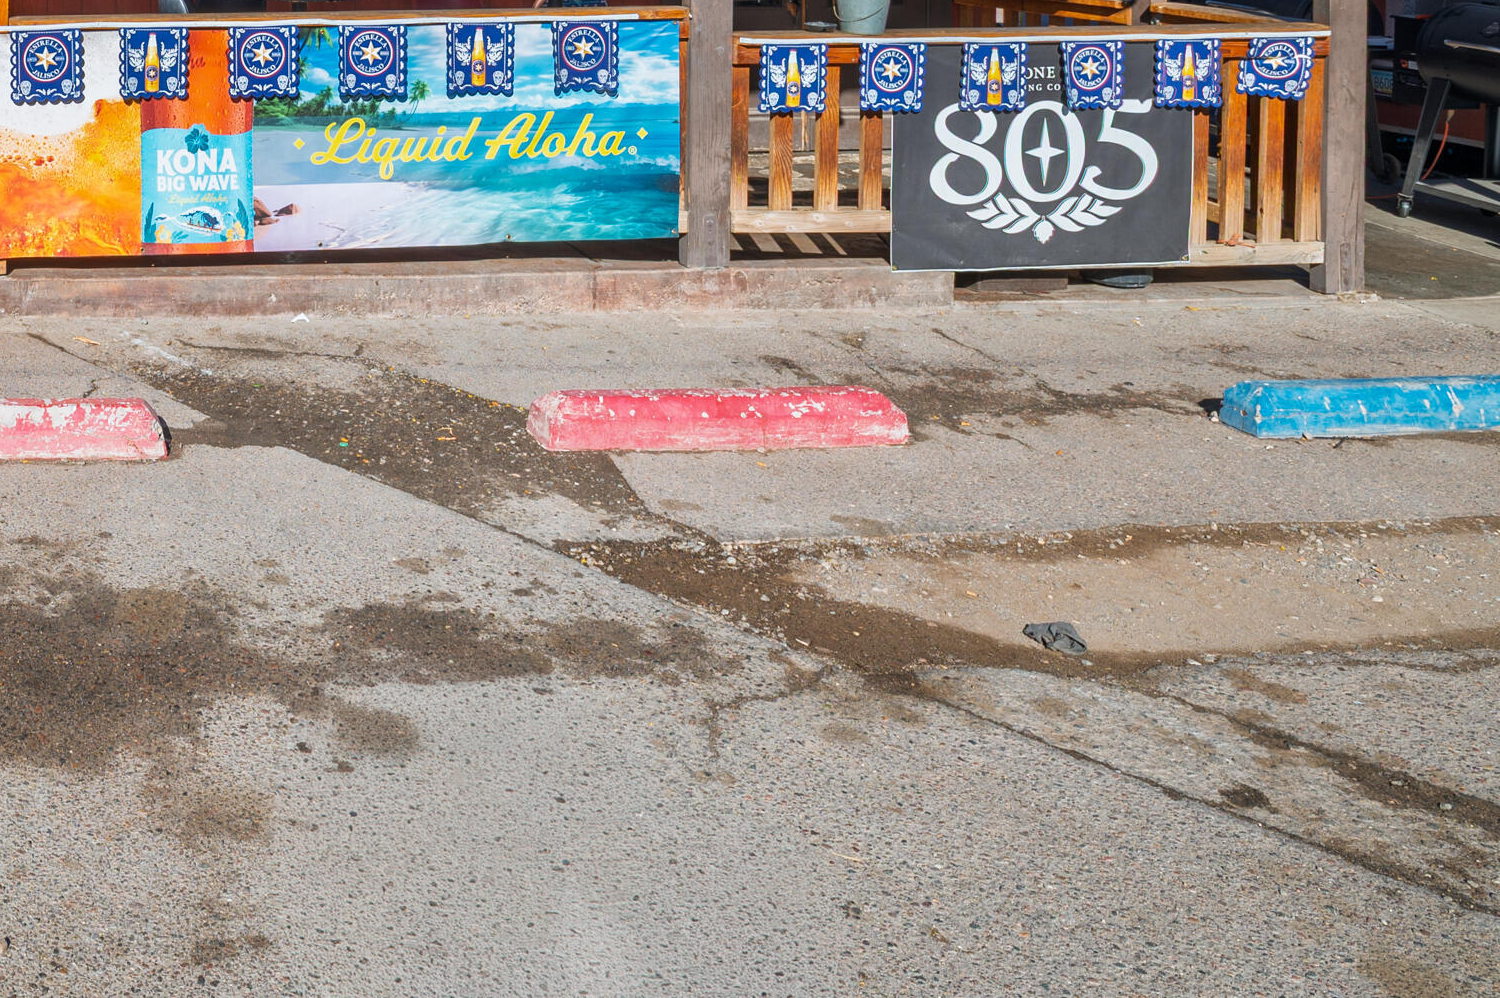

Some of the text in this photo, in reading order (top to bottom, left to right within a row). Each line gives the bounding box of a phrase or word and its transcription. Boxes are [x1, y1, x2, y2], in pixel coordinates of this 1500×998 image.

[246, 36, 280, 50] ESTRELLA
[354, 34, 388, 48] ESTRELLA
[568, 30, 600, 43] ESTRELLA
[30, 40, 63, 54] ESTRELLA
[571, 57, 597, 67] JALISCO
[876, 51, 907, 65] ESTRELLA
[1076, 50, 1107, 63] ESTRELLA
[33, 69, 60, 78] JALISCO
[249, 65, 277, 74] JALISCO
[357, 63, 385, 72] JALISCO
[1259, 66, 1287, 76] JALISCO
[879, 79, 904, 88] JALISCO
[1079, 77, 1104, 85] JALISCO
[310, 117, 482, 180] Liquid
[929, 100, 1159, 205] 805
[156, 149, 236, 176] KONA
[157, 174, 240, 191] BIG WAVE
